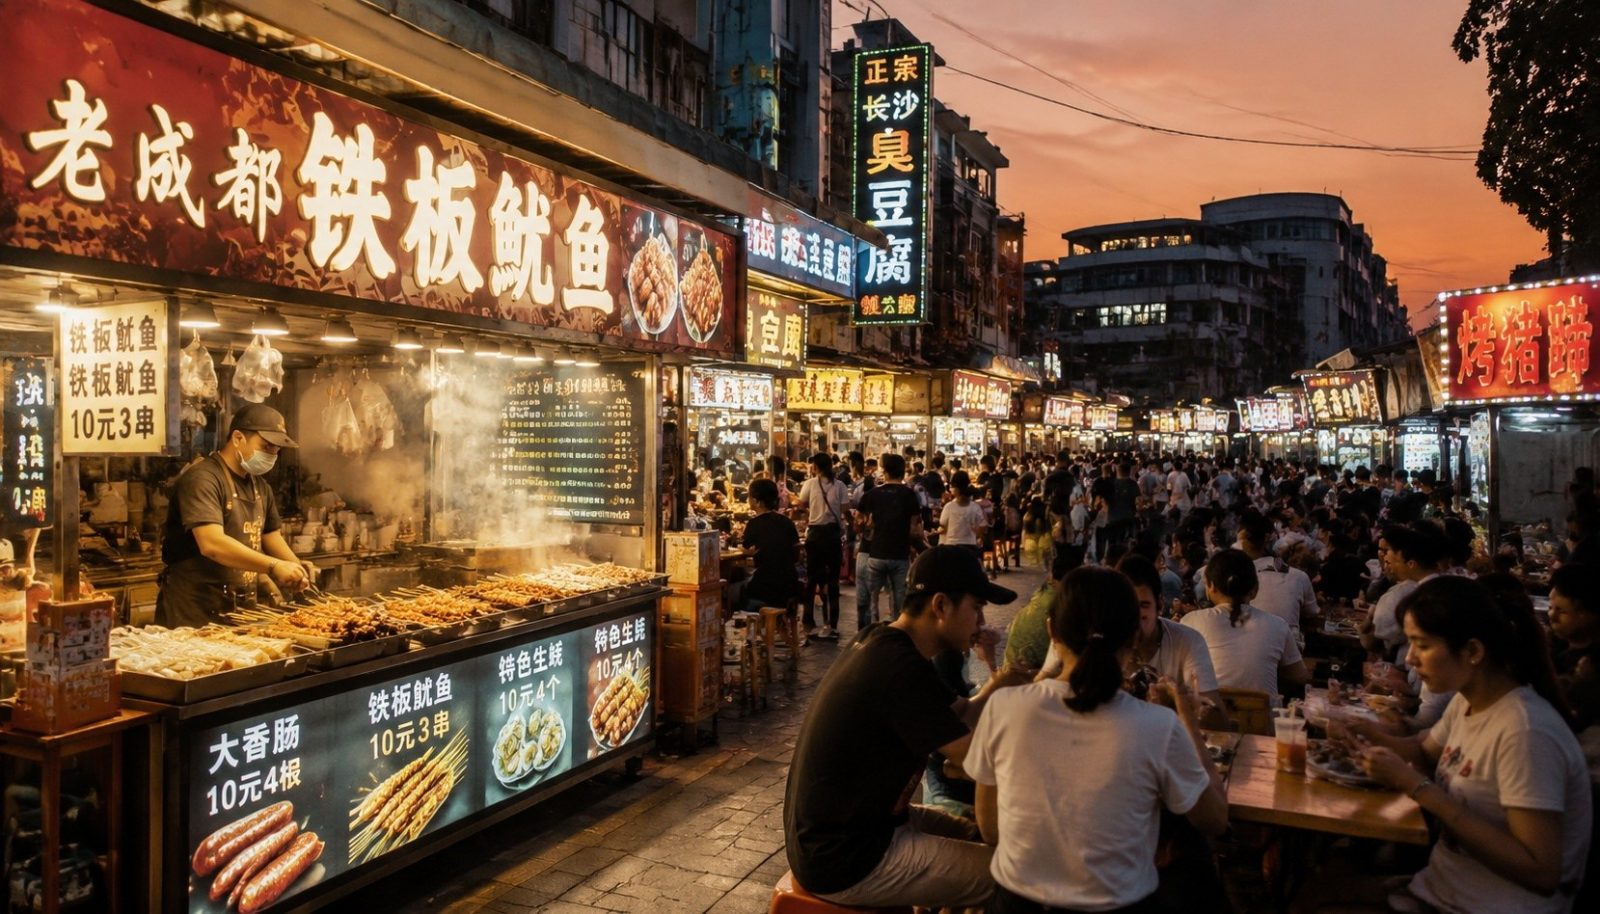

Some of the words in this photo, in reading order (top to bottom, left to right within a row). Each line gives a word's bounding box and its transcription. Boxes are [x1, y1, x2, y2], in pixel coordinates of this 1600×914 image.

[862, 89, 920, 122] 长沙
[28, 79, 614, 315] 老成都铁板鱿鱼
[69, 315, 157, 354] 铁板鱿鱼
[1457, 295, 1593, 387] 烤猪蹄
[69, 359, 158, 398] 铁板鱿鱼
[71, 405, 155, 440] 10元3串
[368, 672, 453, 725] 铁板鱿鱼
[499, 674, 561, 715] 10元4个
[208, 713, 300, 776] 大香肠
[369, 710, 450, 760] 10元3串
